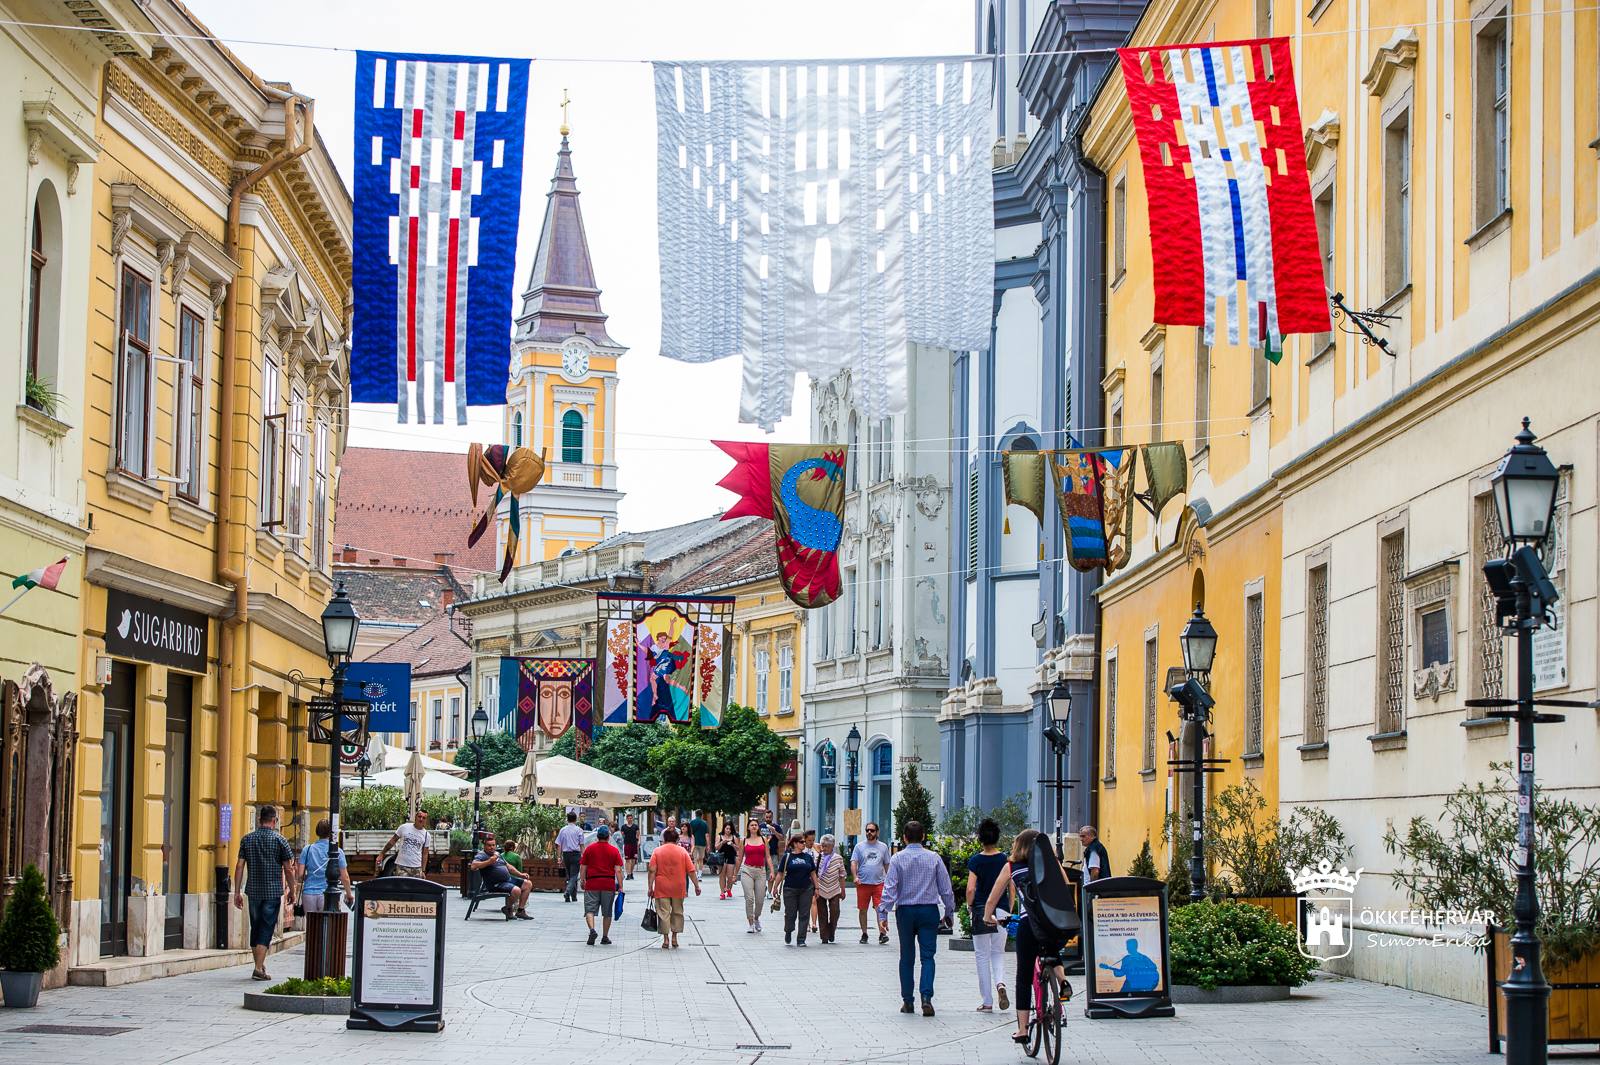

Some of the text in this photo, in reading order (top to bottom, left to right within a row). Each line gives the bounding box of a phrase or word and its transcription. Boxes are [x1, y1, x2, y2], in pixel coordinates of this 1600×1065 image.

[133, 610, 201, 656] SUGARBIRD
[370, 700, 396, 712] otért
[448, 864, 460, 874] FR
[538, 868, 559, 878] FRE
[388, 904, 434, 914] Herbarius
